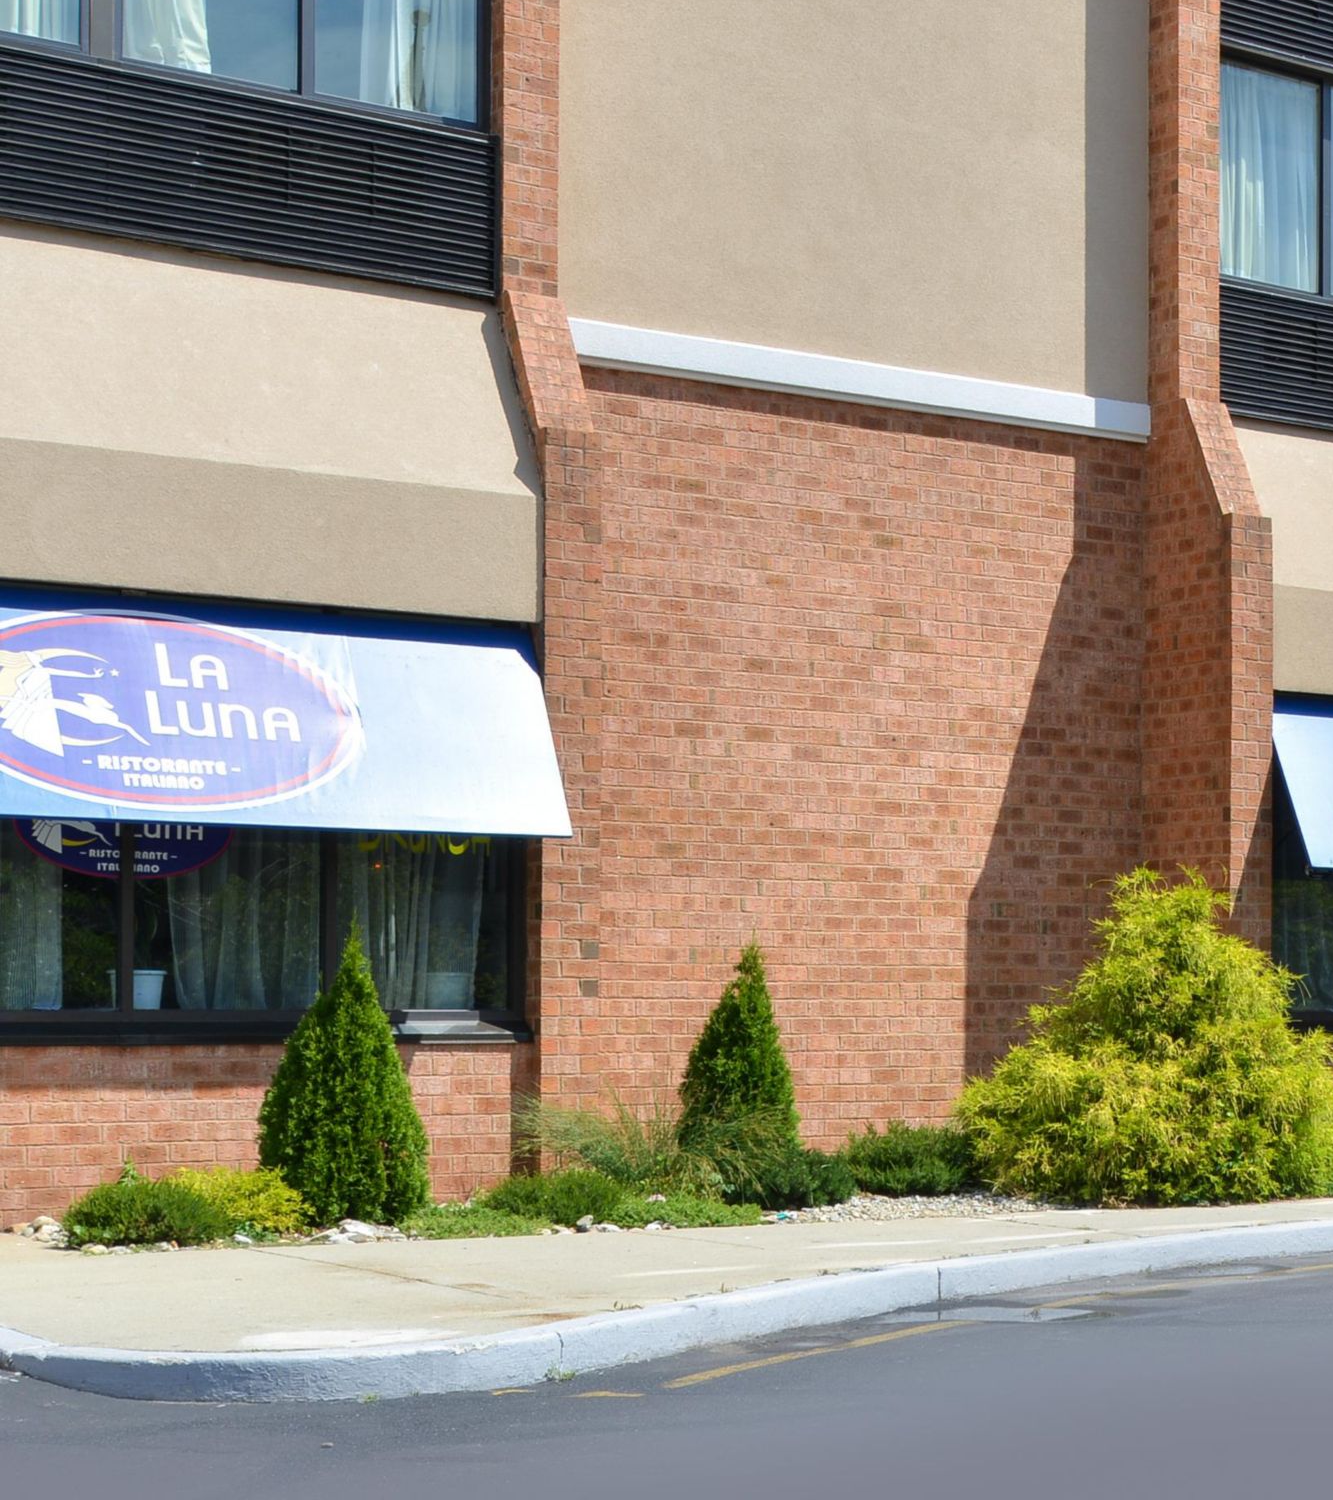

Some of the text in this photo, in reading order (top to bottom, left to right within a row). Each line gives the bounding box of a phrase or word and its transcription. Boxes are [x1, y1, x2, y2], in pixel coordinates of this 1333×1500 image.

[154, 642, 229, 690] LA
[144, 689, 302, 743] LUNA
[97, 754, 228, 777] RISTORANTE
[123, 772, 205, 791] ITALIANO
[88, 848, 169, 861] RISTORANTE
